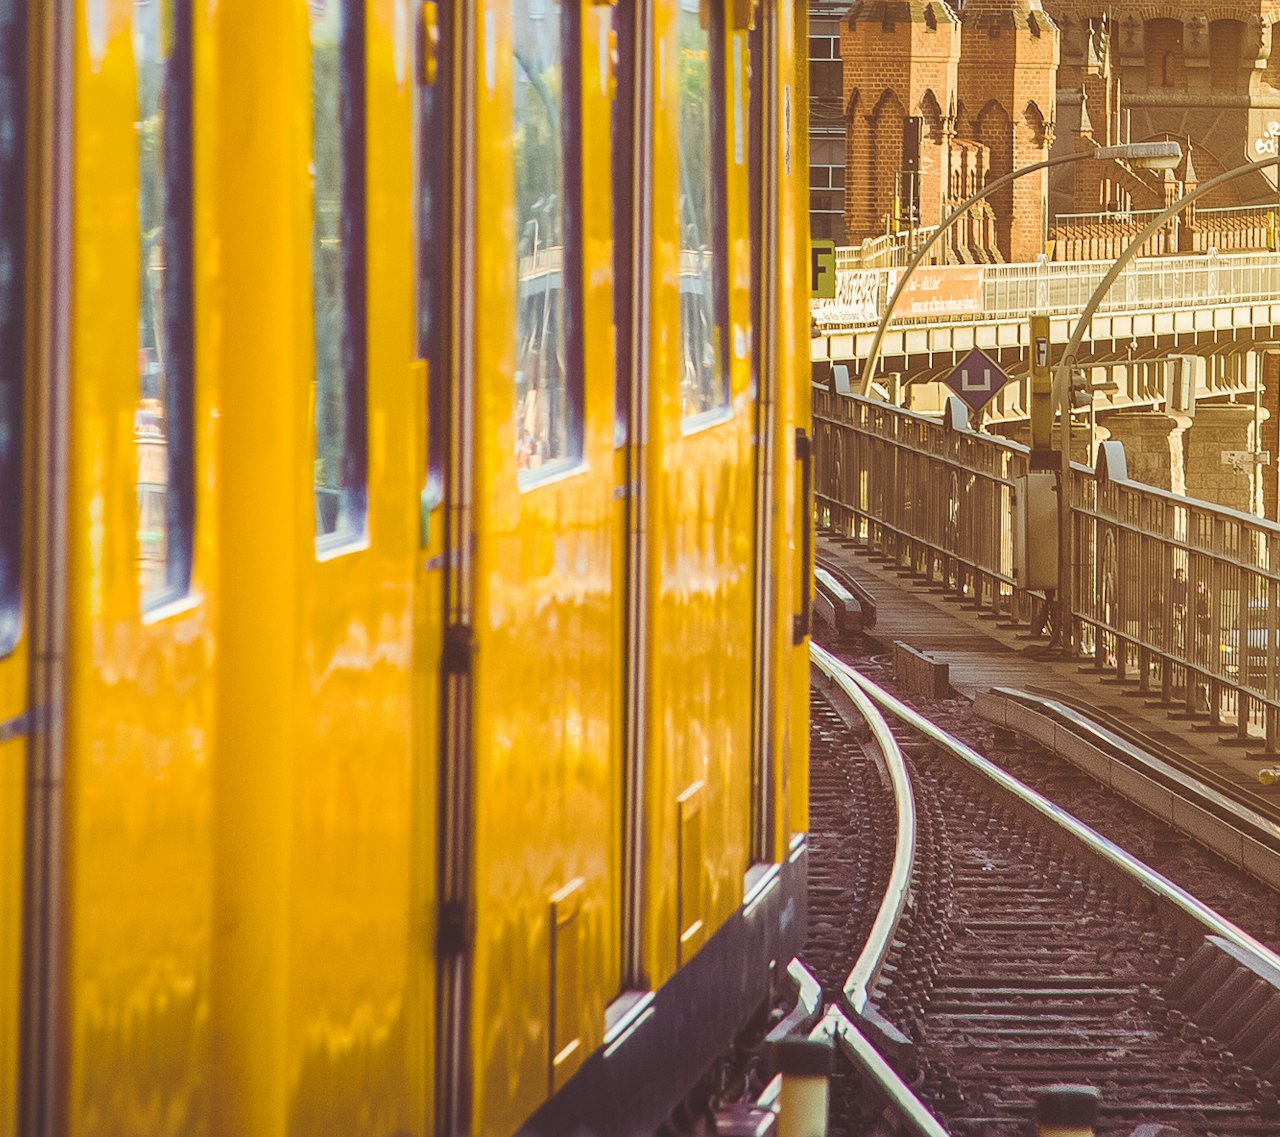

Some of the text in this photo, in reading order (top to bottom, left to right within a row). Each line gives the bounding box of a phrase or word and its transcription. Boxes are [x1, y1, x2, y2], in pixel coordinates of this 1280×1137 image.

[812, 248, 832, 291] F
[1036, 340, 1046, 365] F
[961, 368, 991, 392] U
